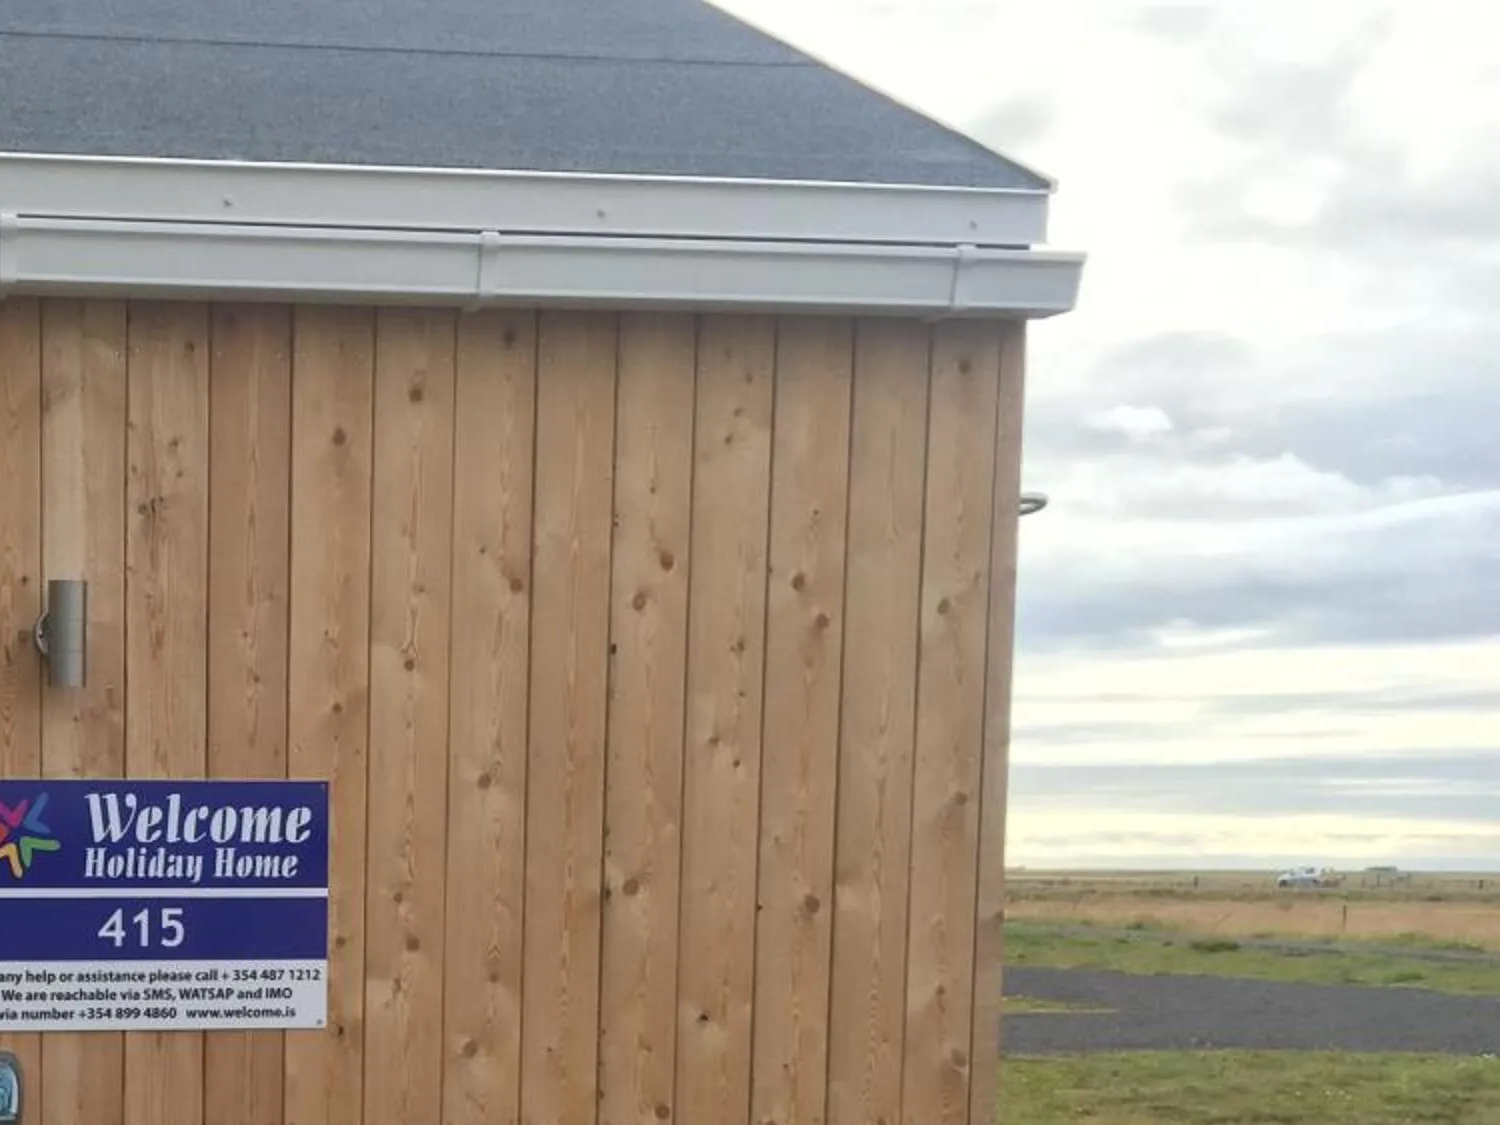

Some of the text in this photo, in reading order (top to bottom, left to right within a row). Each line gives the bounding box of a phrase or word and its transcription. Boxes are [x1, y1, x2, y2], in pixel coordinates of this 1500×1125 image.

[83, 793, 312, 844] Welcome
[84, 847, 299, 884] Holiday Home
[97, 908, 185, 947] 415
[25, 970, 56, 984] help
[59, 972, 73, 983] or
[77, 970, 147, 983] assistance
[150, 969, 192, 984] please
[195, 969, 218, 981] call
[233, 969, 257, 981] 354
[260, 969, 284, 981] 487
[289, 969, 321, 981] 1212
[1, 987, 293, 1002] We are reachable via SMS, WATSAP and IMO
[21, 1008, 75, 1020] number
[78, 1008, 112, 1020] +354
[115, 1007, 140, 1019] 899
[144, 1007, 177, 1019] 4860
[185, 1006, 296, 1019] www.welcome.is
